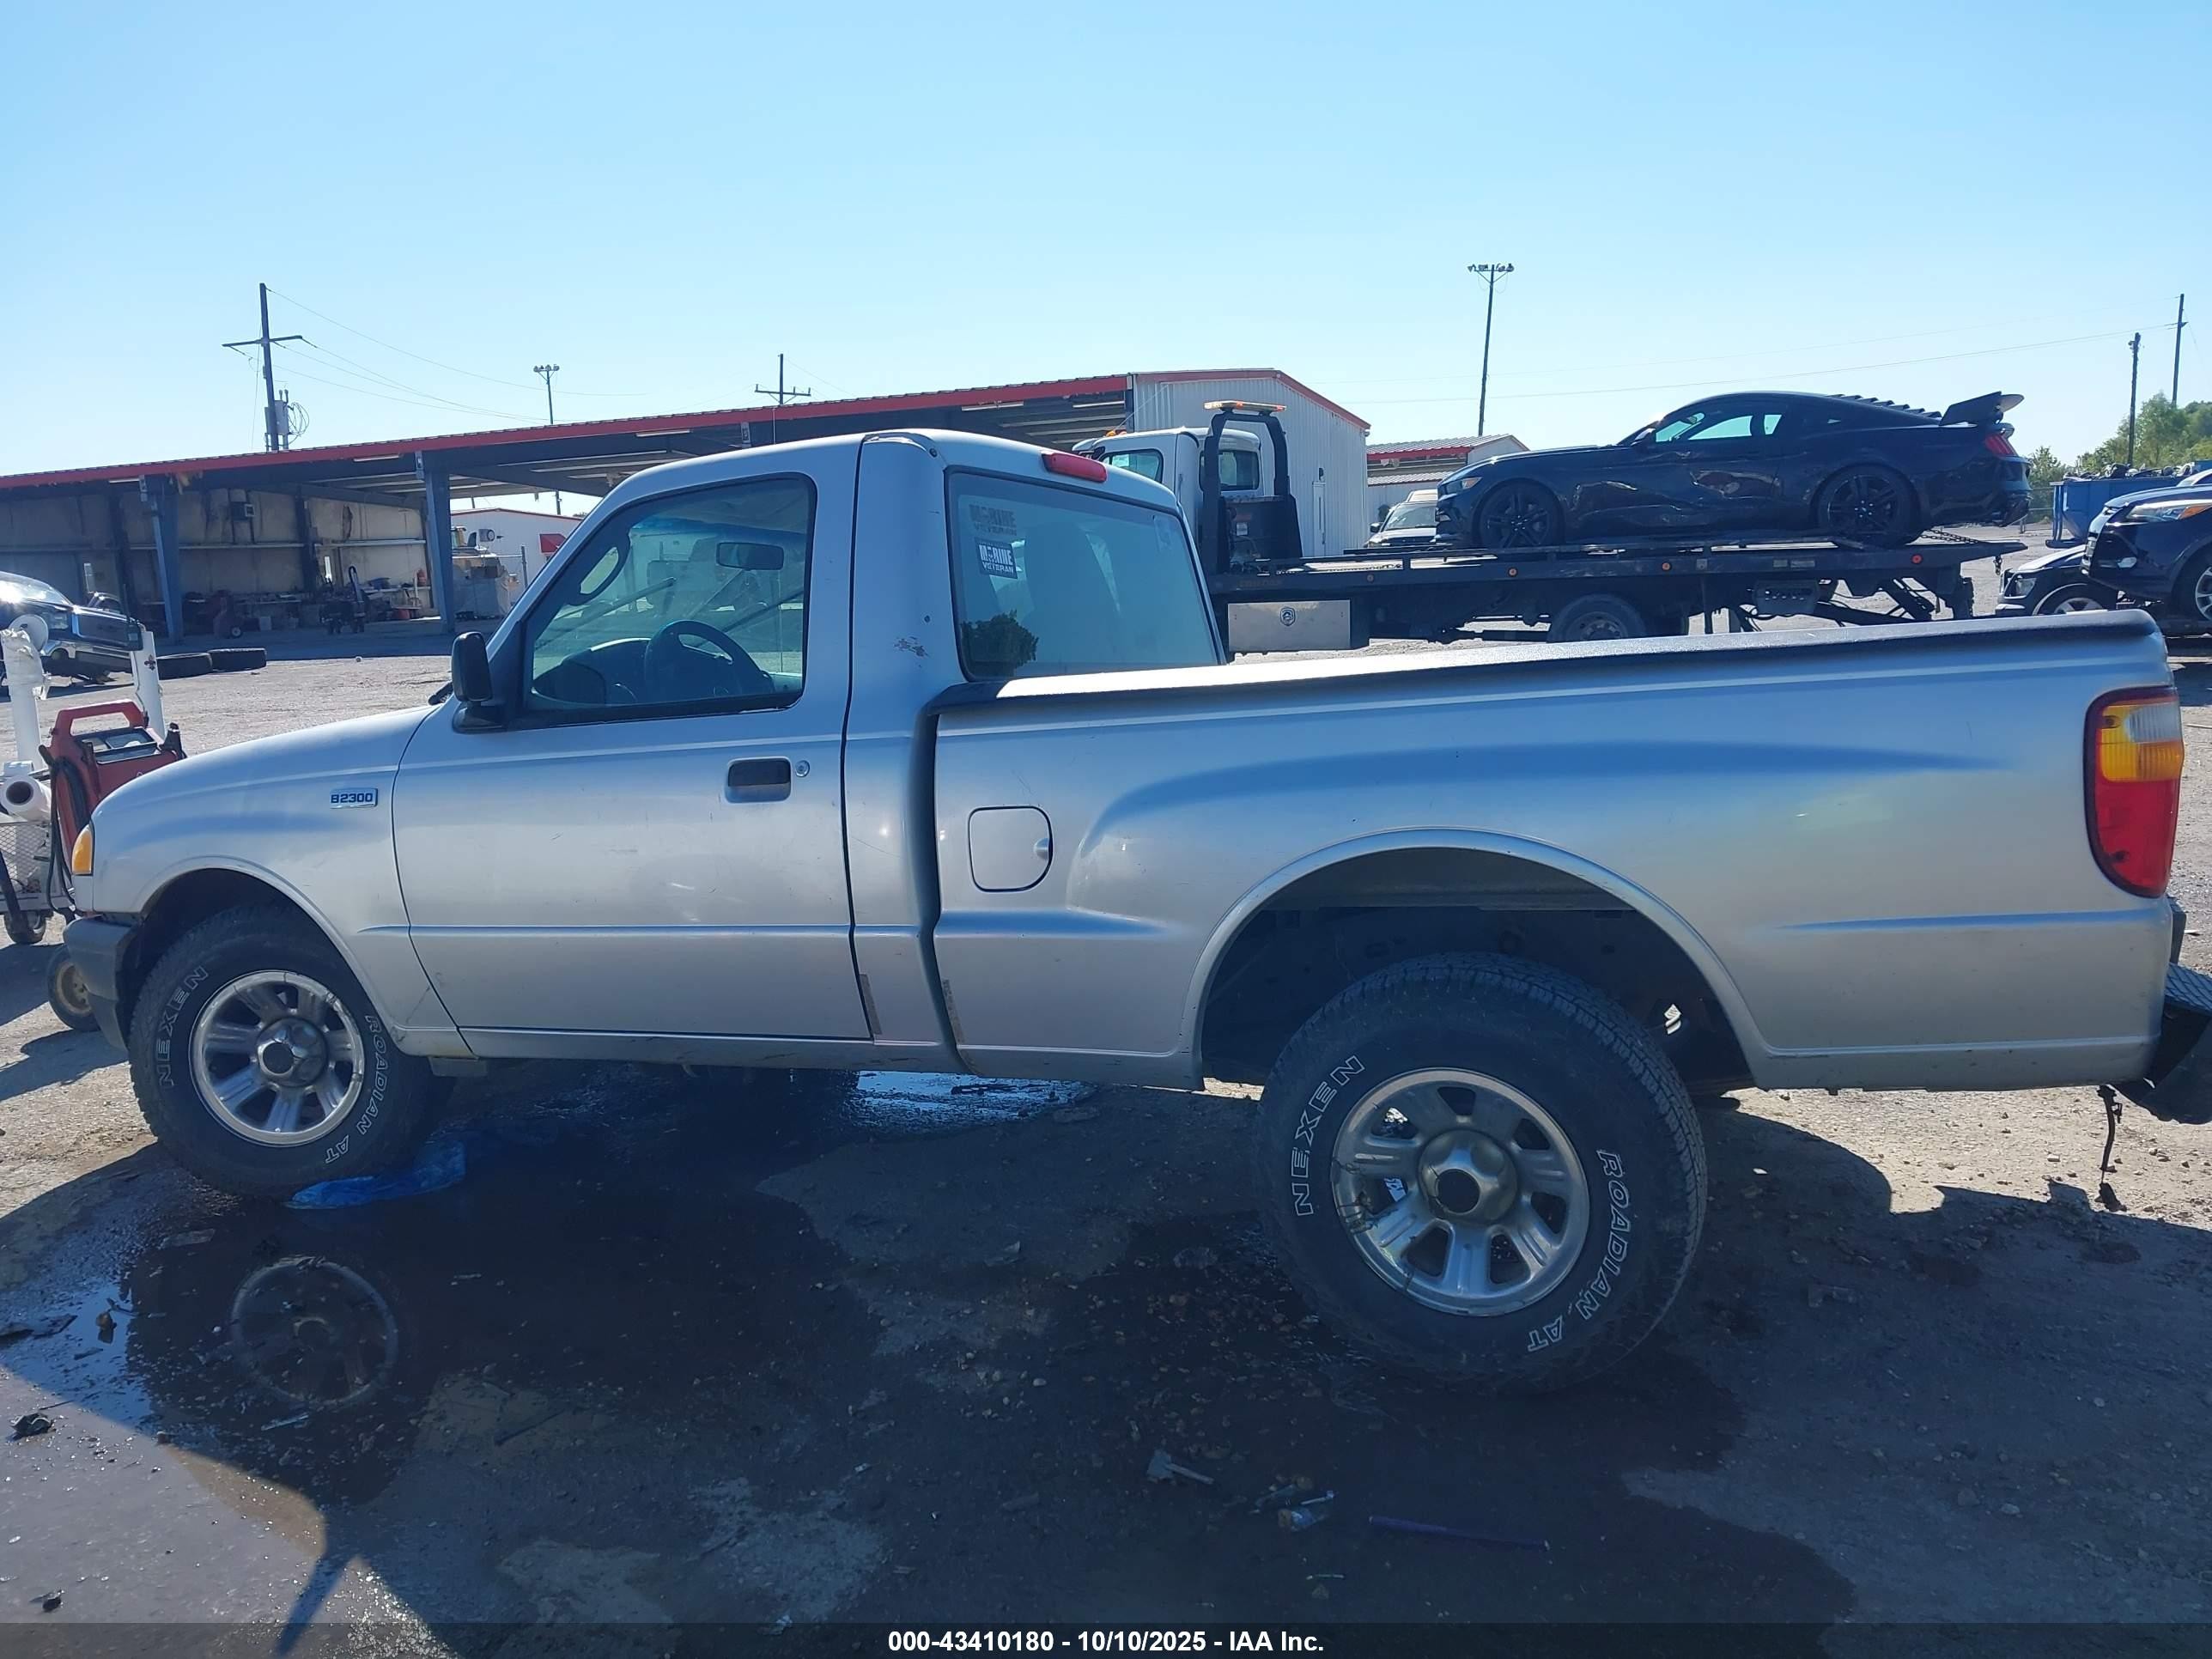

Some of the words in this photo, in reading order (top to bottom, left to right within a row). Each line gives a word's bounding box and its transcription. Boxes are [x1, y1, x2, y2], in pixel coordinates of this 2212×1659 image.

[982, 562, 1014, 574] VETERAN
[331, 793, 374, 804] B2300
[155, 965, 209, 1087] NEXEN
[357, 1015, 392, 1135] ROADIAN
[325, 1134, 350, 1164] AT
[1291, 1055, 1366, 1217] NEXEN
[1574, 1148, 1632, 1322] ROADIAN
[1527, 1316, 1564, 1353] AT
